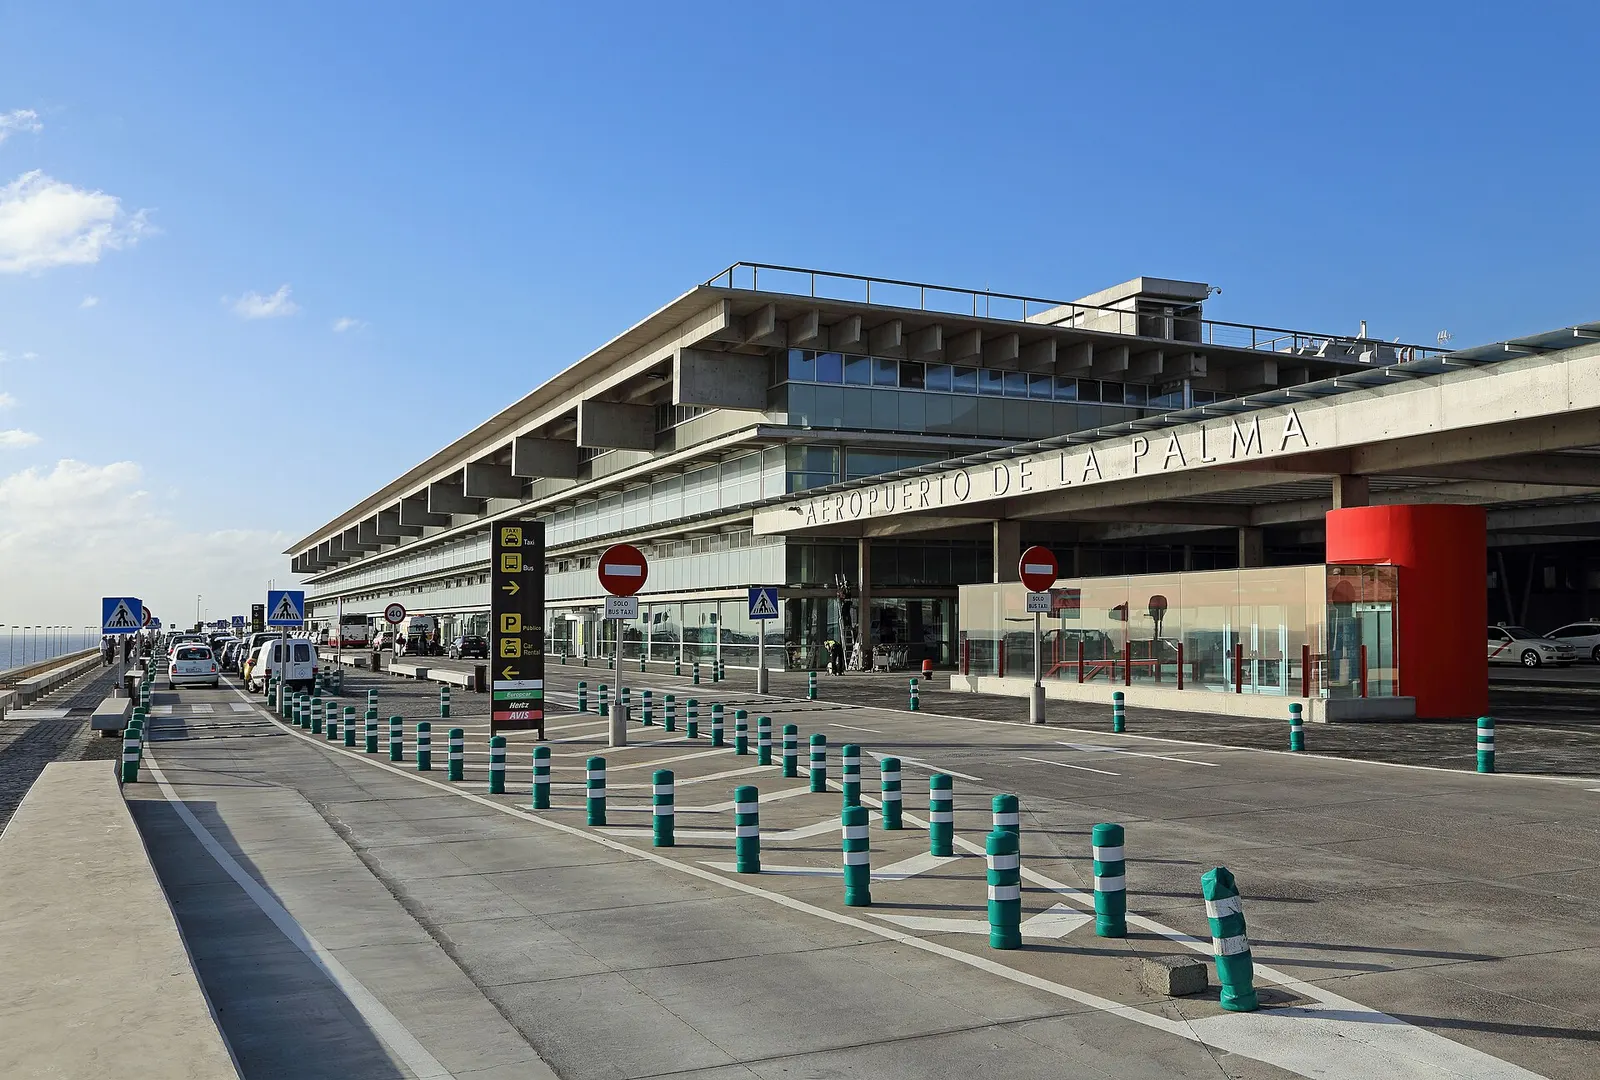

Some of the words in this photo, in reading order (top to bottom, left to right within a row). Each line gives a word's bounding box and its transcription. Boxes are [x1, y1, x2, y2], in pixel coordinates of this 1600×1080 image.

[806, 469, 971, 525] AEROPUERTO
[993, 458, 1033, 497] DE
[1059, 447, 1102, 485] LA
[1132, 408, 1309, 474] PALMA
[506, 617, 516, 630] P
[510, 711, 529, 719] AVIS
